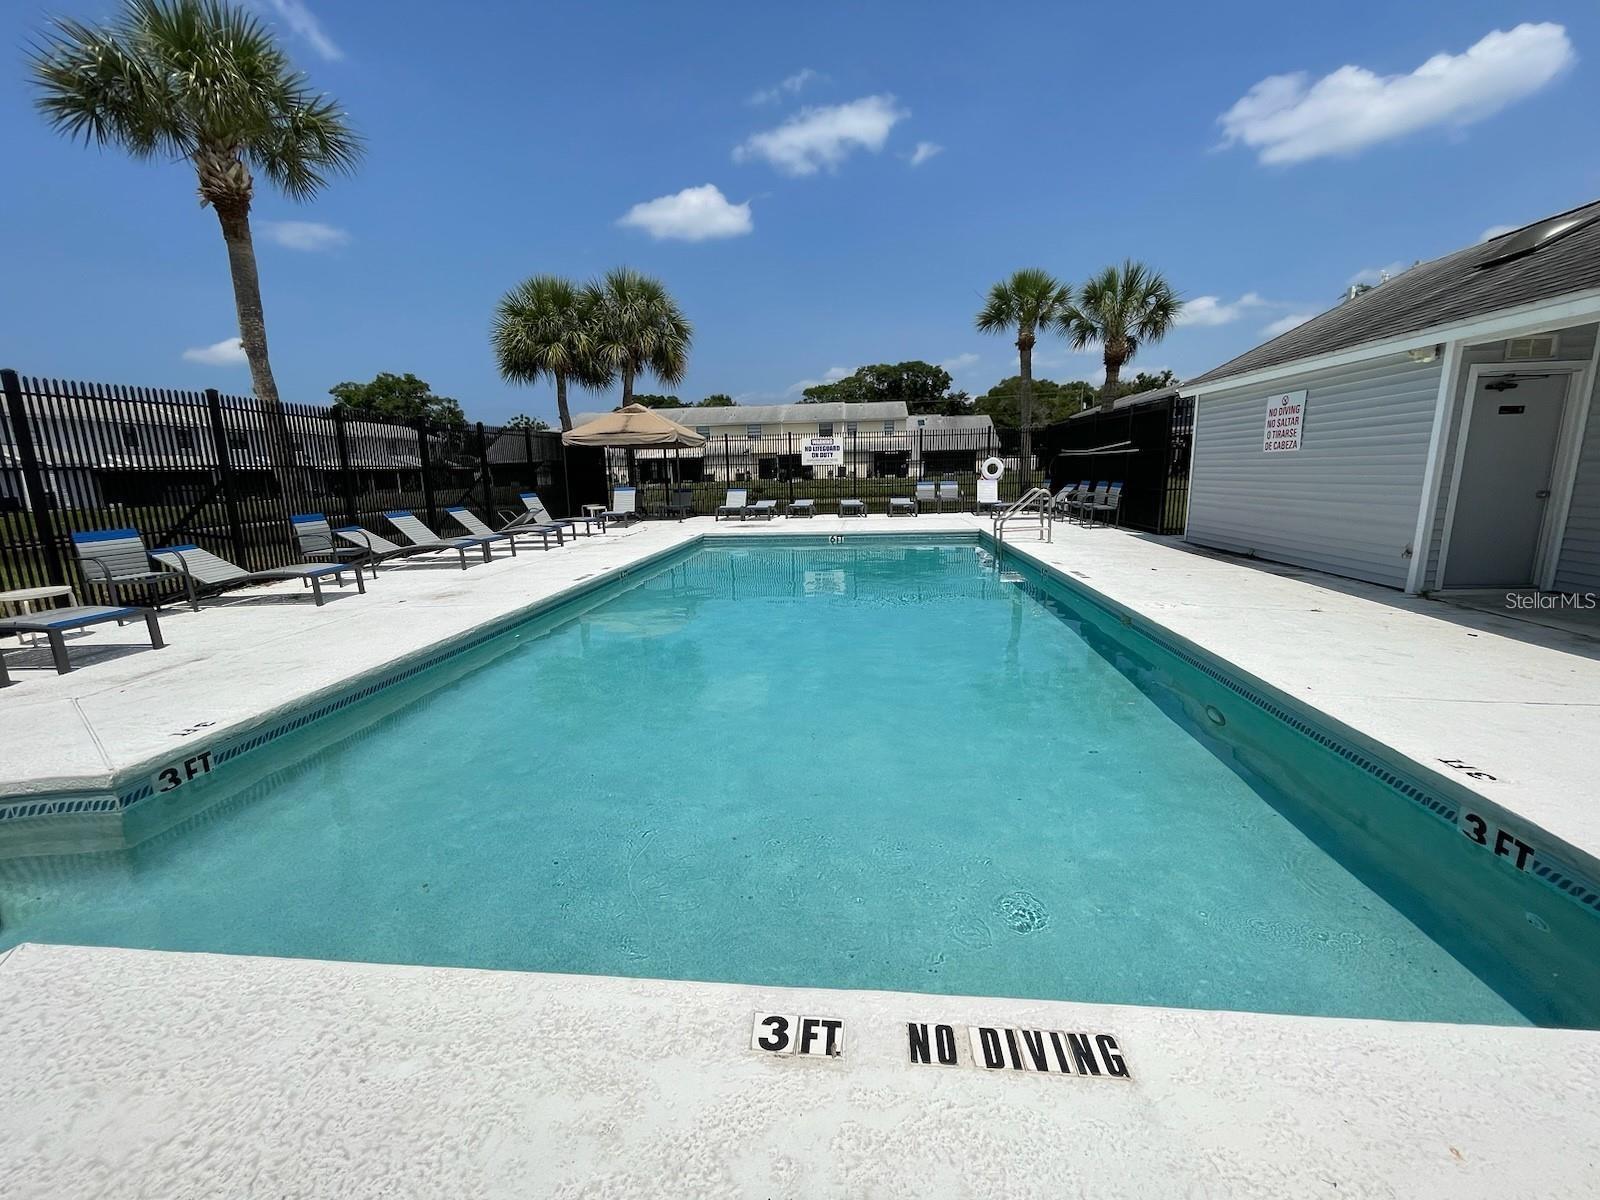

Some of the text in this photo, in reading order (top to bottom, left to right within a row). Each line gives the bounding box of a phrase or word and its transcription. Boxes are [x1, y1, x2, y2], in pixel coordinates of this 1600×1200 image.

[1267, 416, 1299, 428] NO SALTAR
[1269, 405, 1301, 417] NO DIVING
[1265, 440, 1297, 450] DE CABEZA
[1272, 428, 1297, 439] TIRARSE
[158, 751, 211, 792] 3 FT
[1462, 813, 1535, 871] 3 FT
[758, 1016, 842, 1056] 3 FT
[908, 1023, 1131, 1078] NO DIVING
